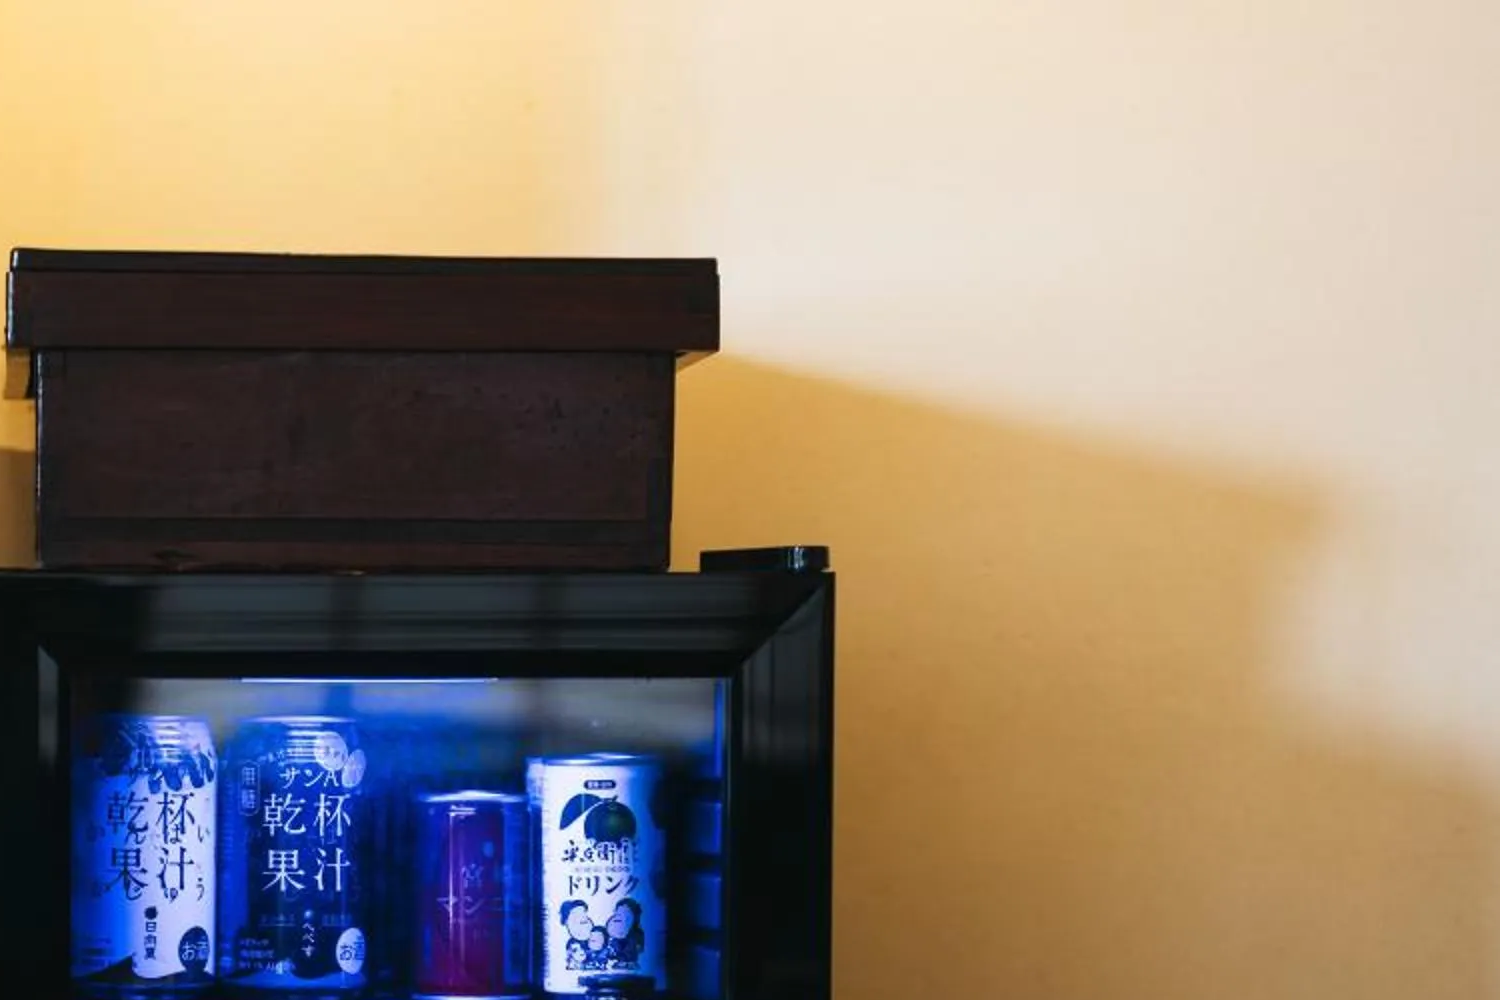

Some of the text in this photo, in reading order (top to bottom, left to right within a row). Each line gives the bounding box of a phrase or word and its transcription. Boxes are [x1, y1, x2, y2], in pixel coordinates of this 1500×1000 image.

[106, 791, 195, 844] 乾杯
[262, 793, 351, 837] 乾杯
[104, 846, 195, 892] 果汁
[261, 847, 351, 892] 果汁
[567, 875, 640, 897] ドリンク
